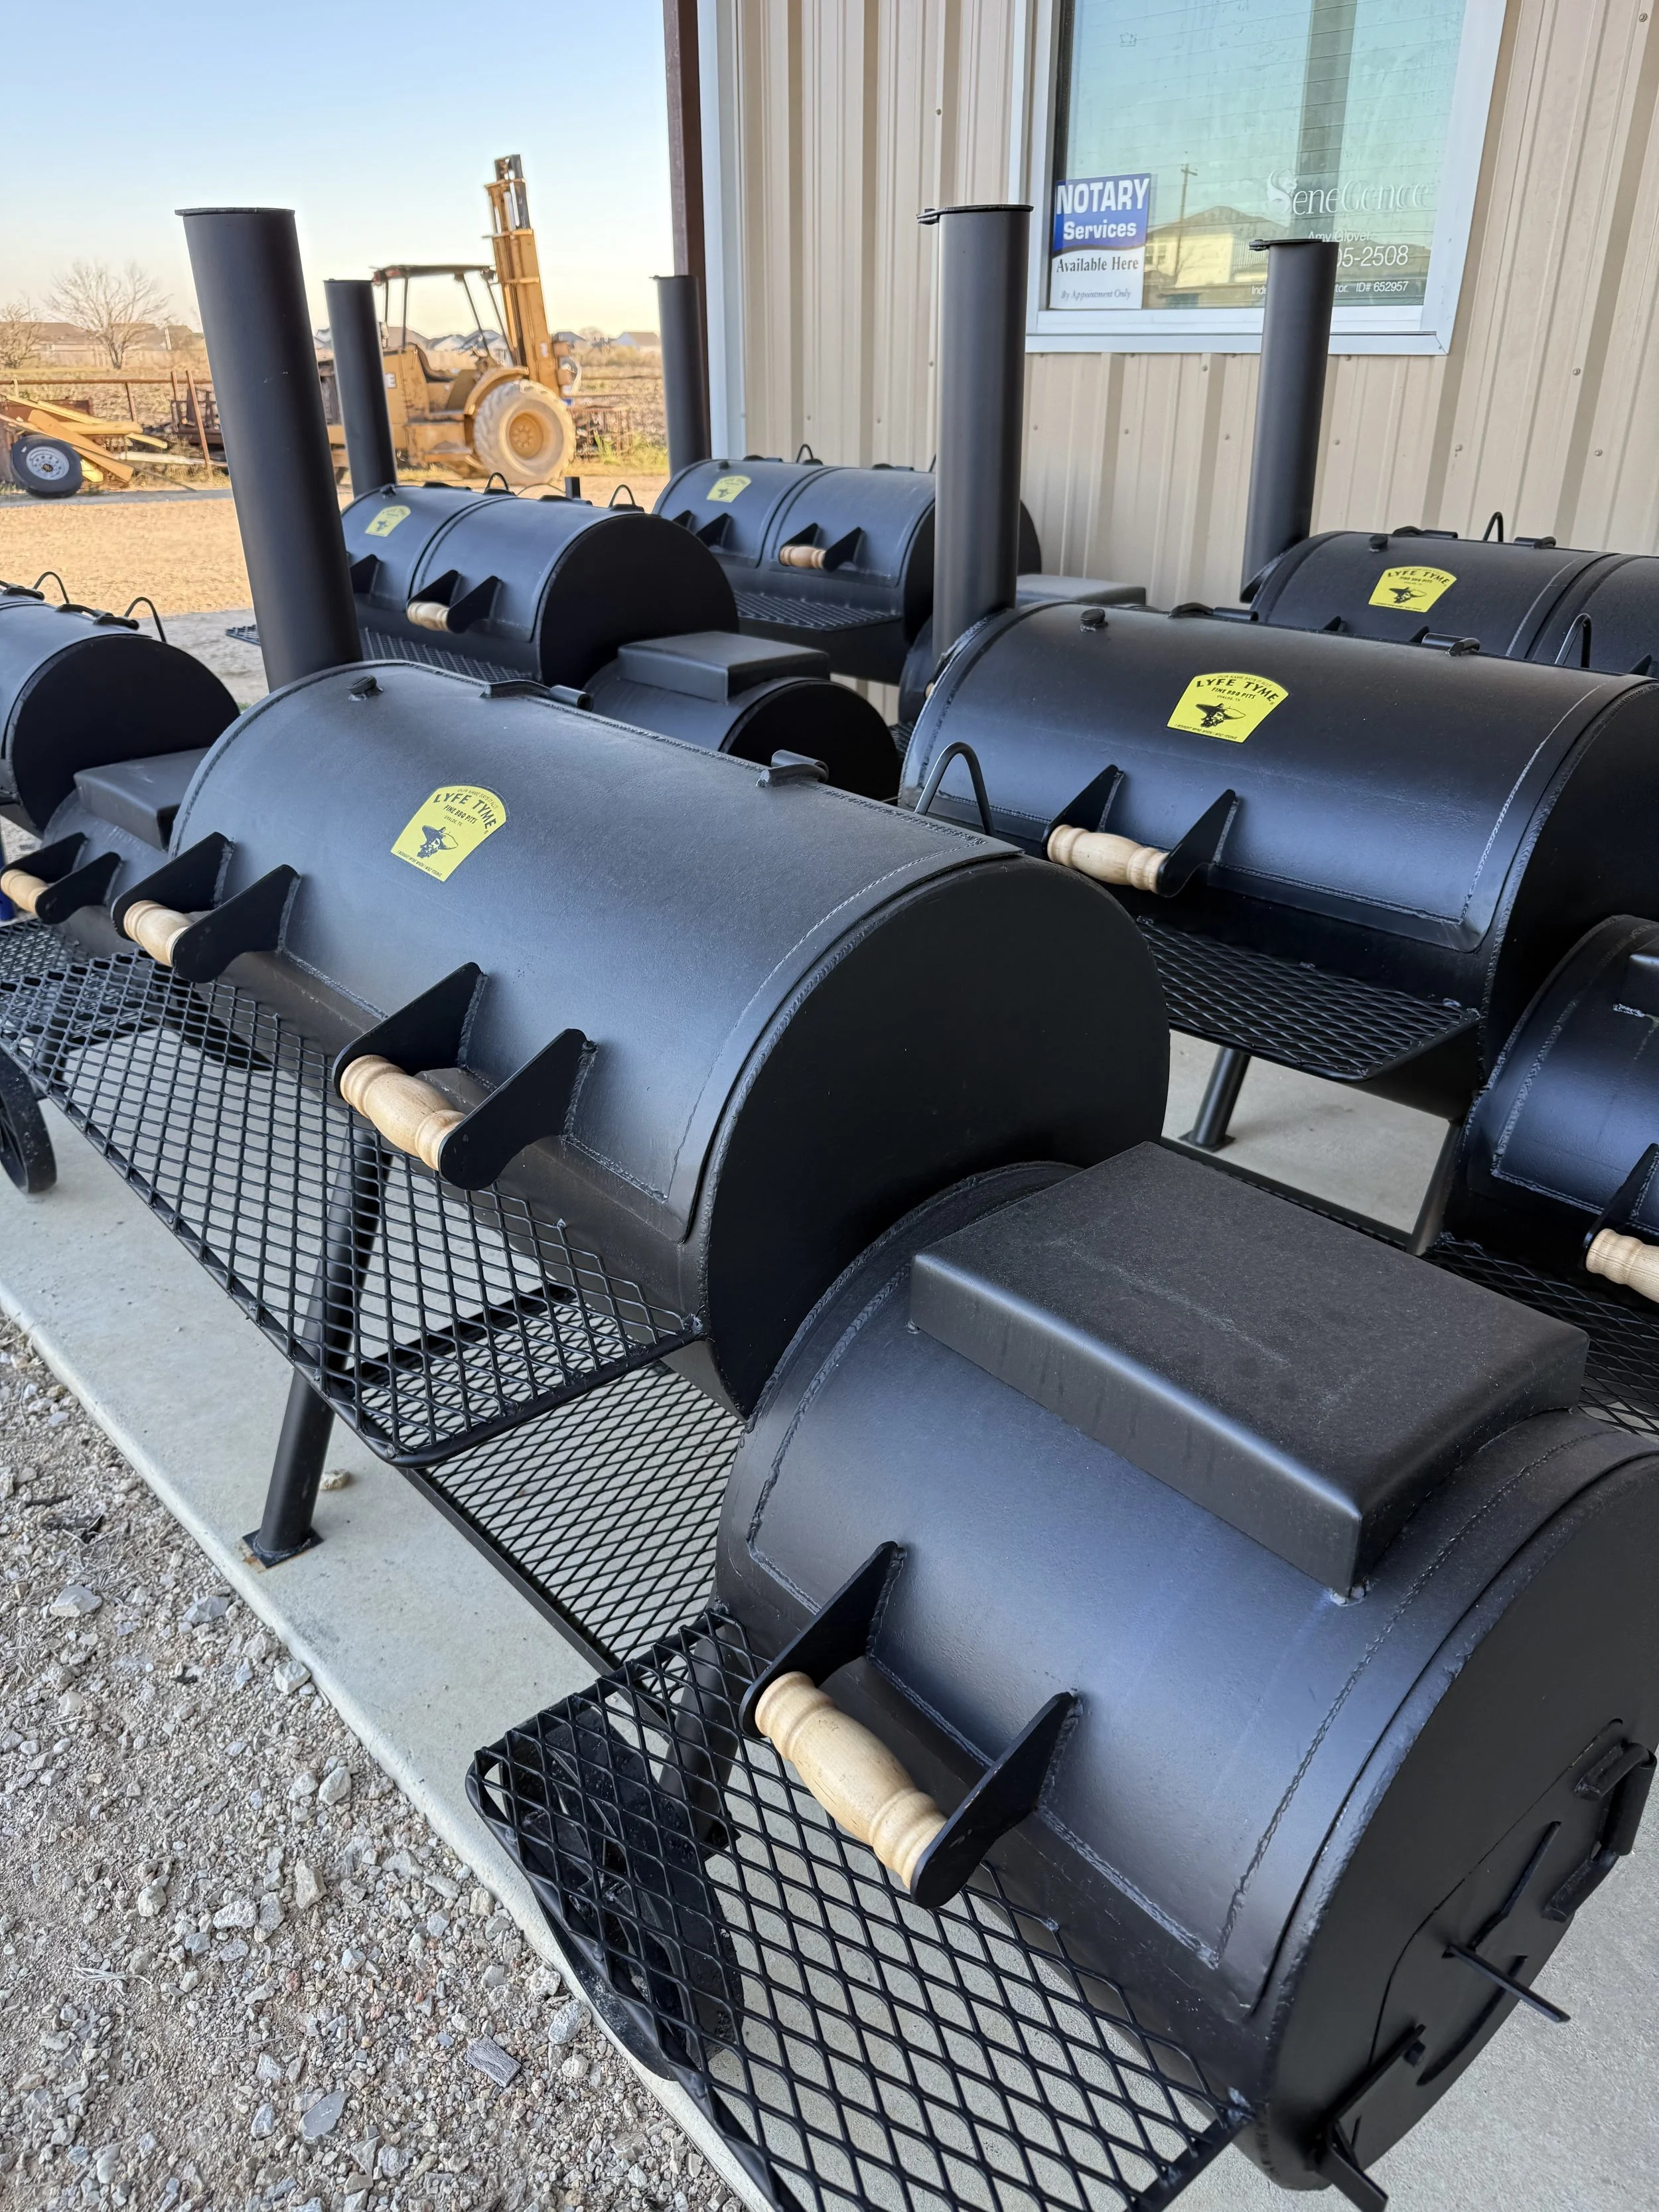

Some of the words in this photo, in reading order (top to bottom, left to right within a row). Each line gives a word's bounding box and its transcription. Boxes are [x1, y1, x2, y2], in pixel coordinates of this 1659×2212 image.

[1056, 177, 1150, 214] NOTARY
[1063, 219, 1137, 240] Services
[1308, 231, 1331, 242] Amy
[1334, 229, 1371, 242] Glover
[1056, 258, 1108, 273] Available
[1112, 256, 1139, 271] Here
[1060, 290, 1070, 300] By
[1071, 291, 1113, 301] Appointment
[1114, 288, 1131, 301] Only
[1356, 281, 1371, 292] ID#
[1373, 281, 1409, 292] 652957
[1423, 571, 1450, 585] TYME
[1196, 678, 1237, 688] LYFE
[1244, 681, 1279, 702] TYME
[433, 793, 472, 804] LYFE
[472, 799, 497, 830] TYME
[443, 804, 457, 814] FINE
[455, 810, 467, 819] BBQ
[465, 814, 478, 824] PITS
